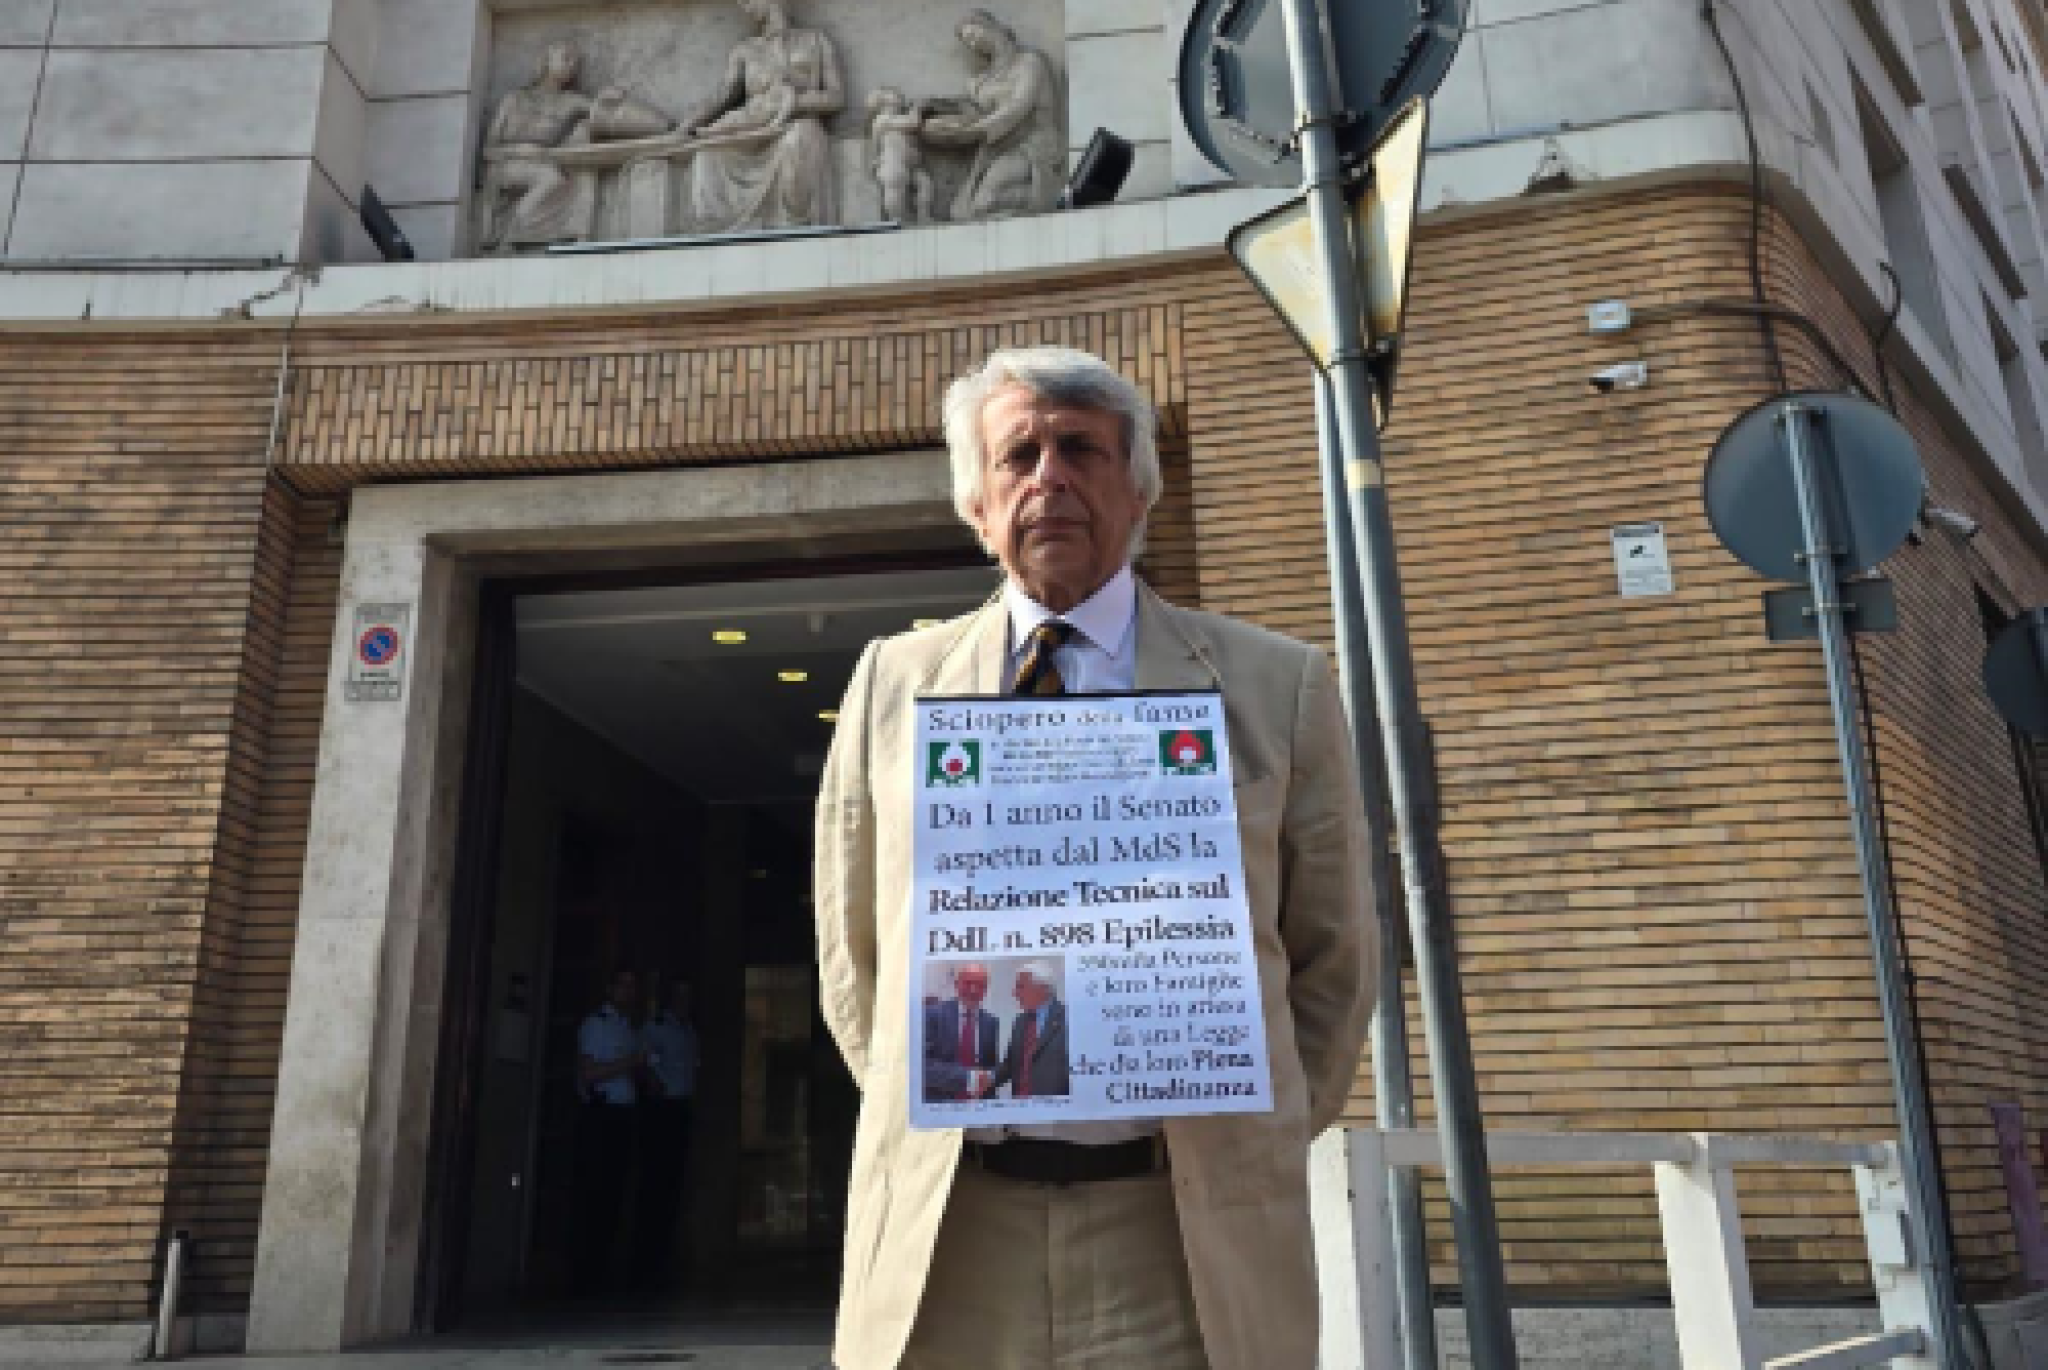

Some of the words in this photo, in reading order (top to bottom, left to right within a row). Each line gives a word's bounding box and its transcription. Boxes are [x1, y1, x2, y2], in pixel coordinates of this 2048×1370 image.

[929, 708, 1066, 734] Sciopero
[929, 803, 972, 829] Da
[1007, 803, 1082, 825] anno
[1093, 796, 1112, 821] il
[1117, 796, 1222, 821] Senato
[933, 845, 1042, 878] aspetta
[1052, 836, 1099, 866] dal
[1109, 832, 1185, 863] MdS
[1188, 829, 1218, 858] la
[927, 885, 1070, 915] Relazione
[1073, 877, 1185, 906] Tecnica
[1187, 873, 1230, 899] sul
[1039, 922, 1094, 948] 898
[1101, 914, 1235, 948] Epilessia
[1105, 1078, 1259, 1104] Cittadinanza
